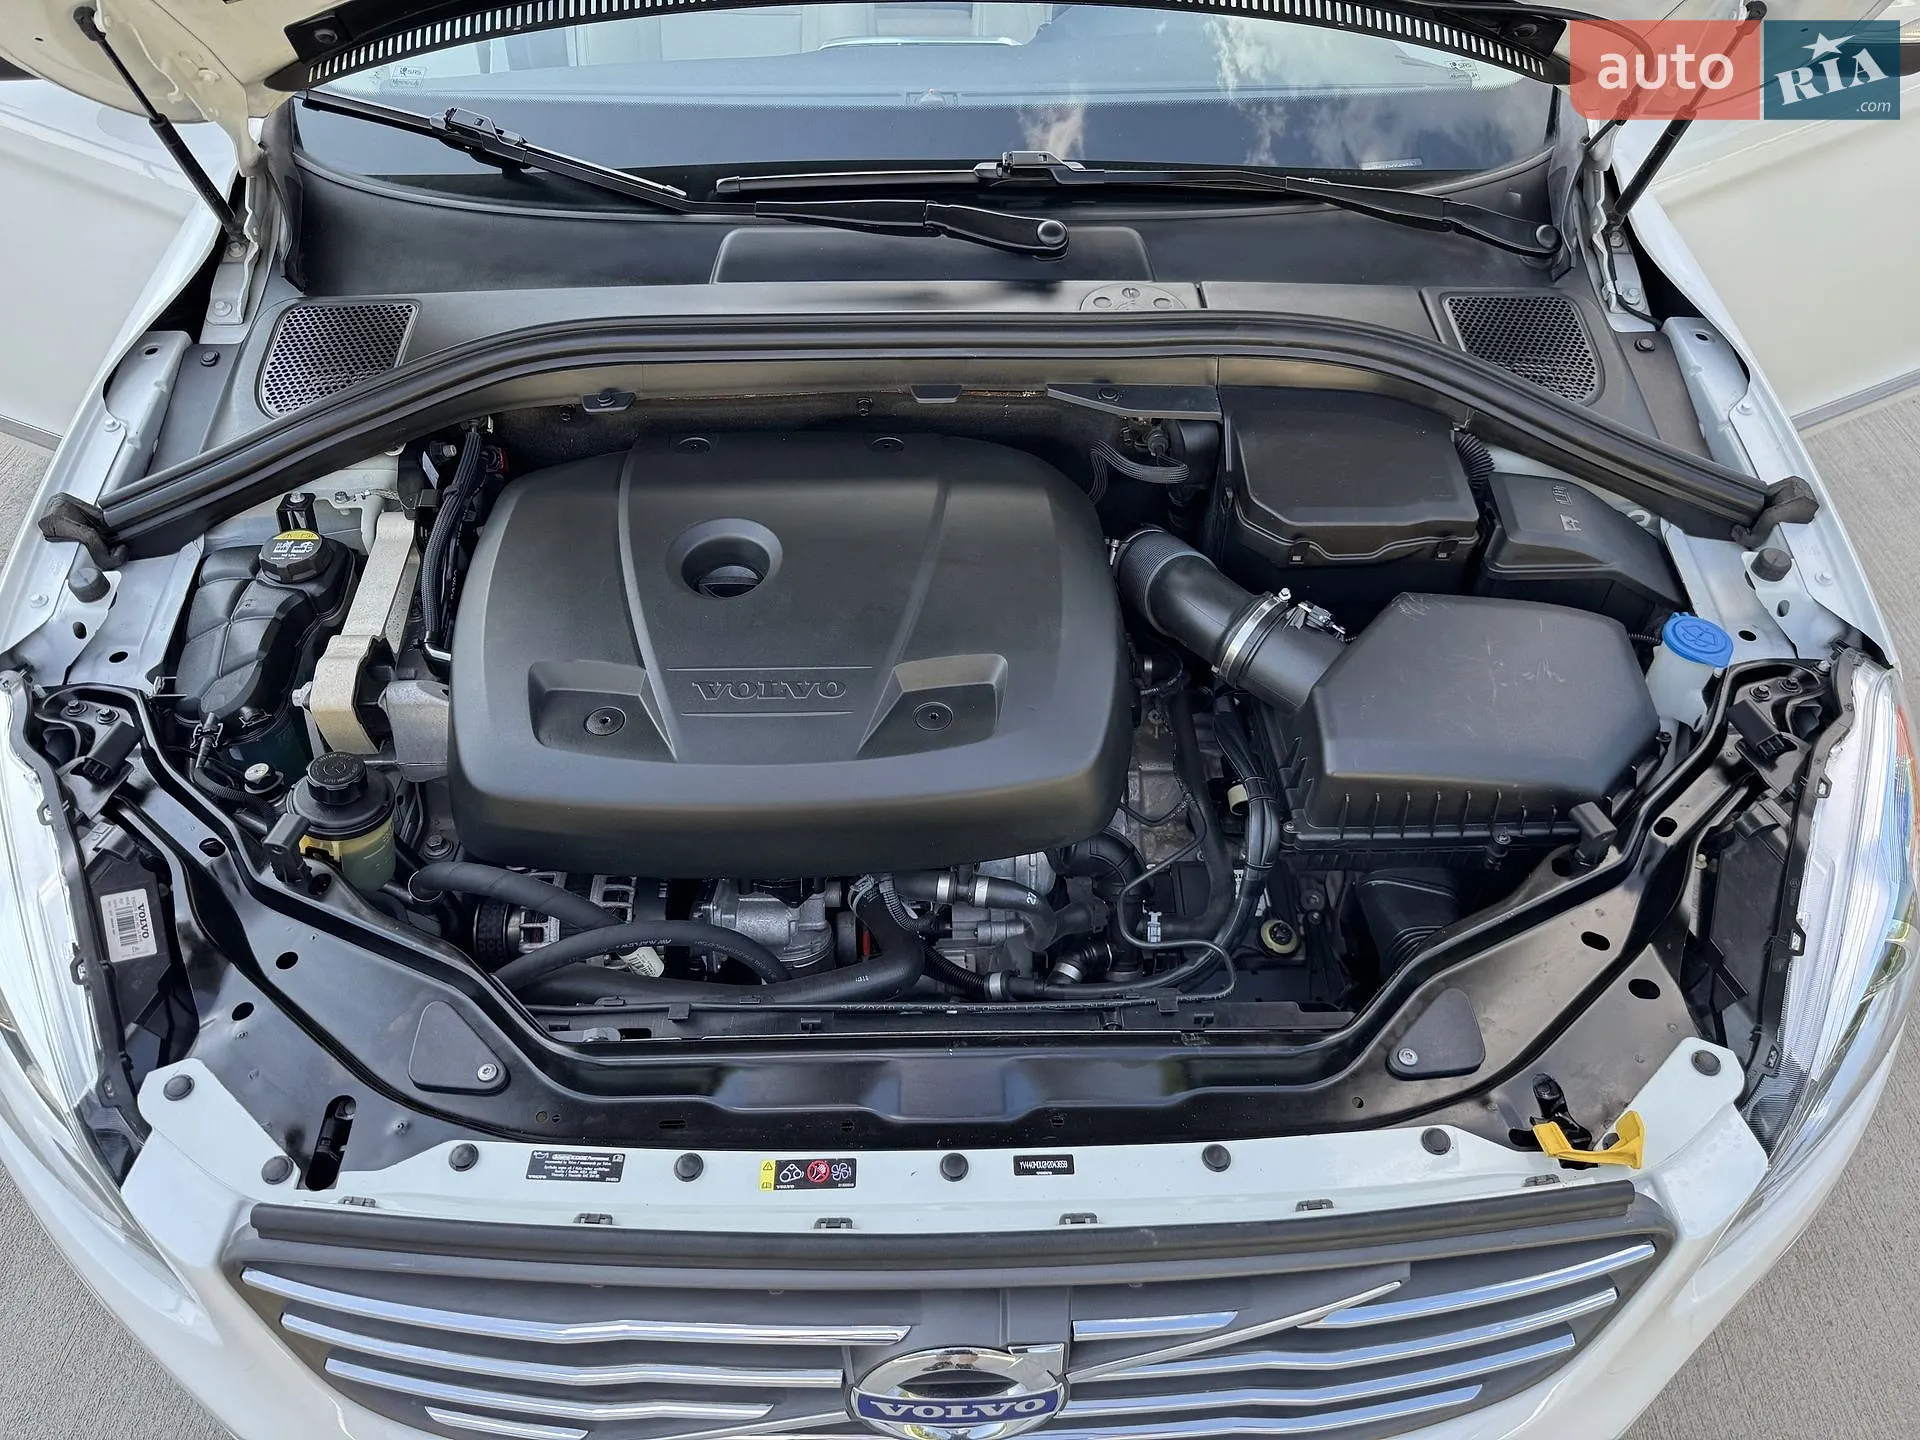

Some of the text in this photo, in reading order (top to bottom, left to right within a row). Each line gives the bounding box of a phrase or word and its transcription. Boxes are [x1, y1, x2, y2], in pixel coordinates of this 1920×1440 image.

[691, 680, 847, 700] VOLVO
[137, 902, 150, 939] VOLVO
[869, 1398, 1047, 1418] VOLVO
